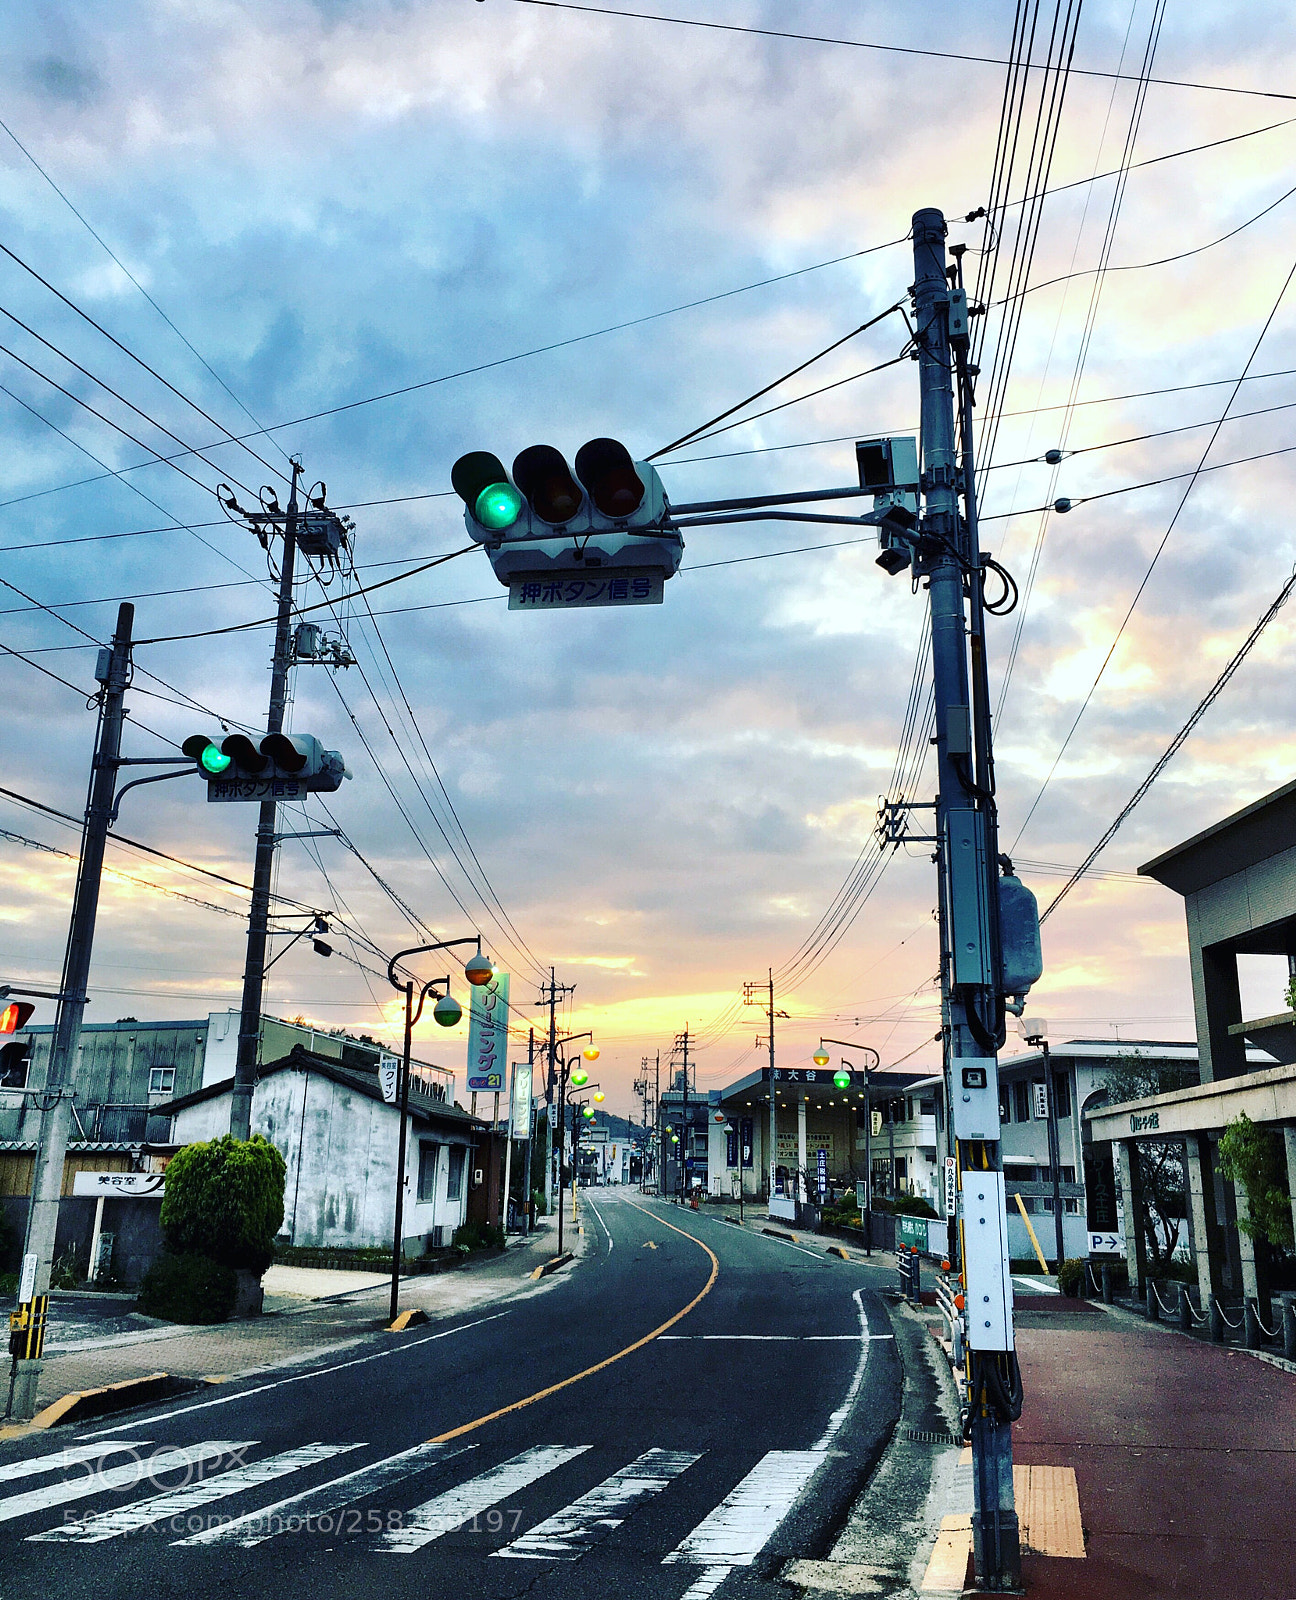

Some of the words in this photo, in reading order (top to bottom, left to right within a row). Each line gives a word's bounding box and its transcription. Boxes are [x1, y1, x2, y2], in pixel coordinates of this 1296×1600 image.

[519, 577, 653, 604] 押ボタン信号
[213, 780, 300, 798] 押ボタン信号
[98, 1175, 137, 1186] 美容室
[1092, 1235, 1103, 1249] P
